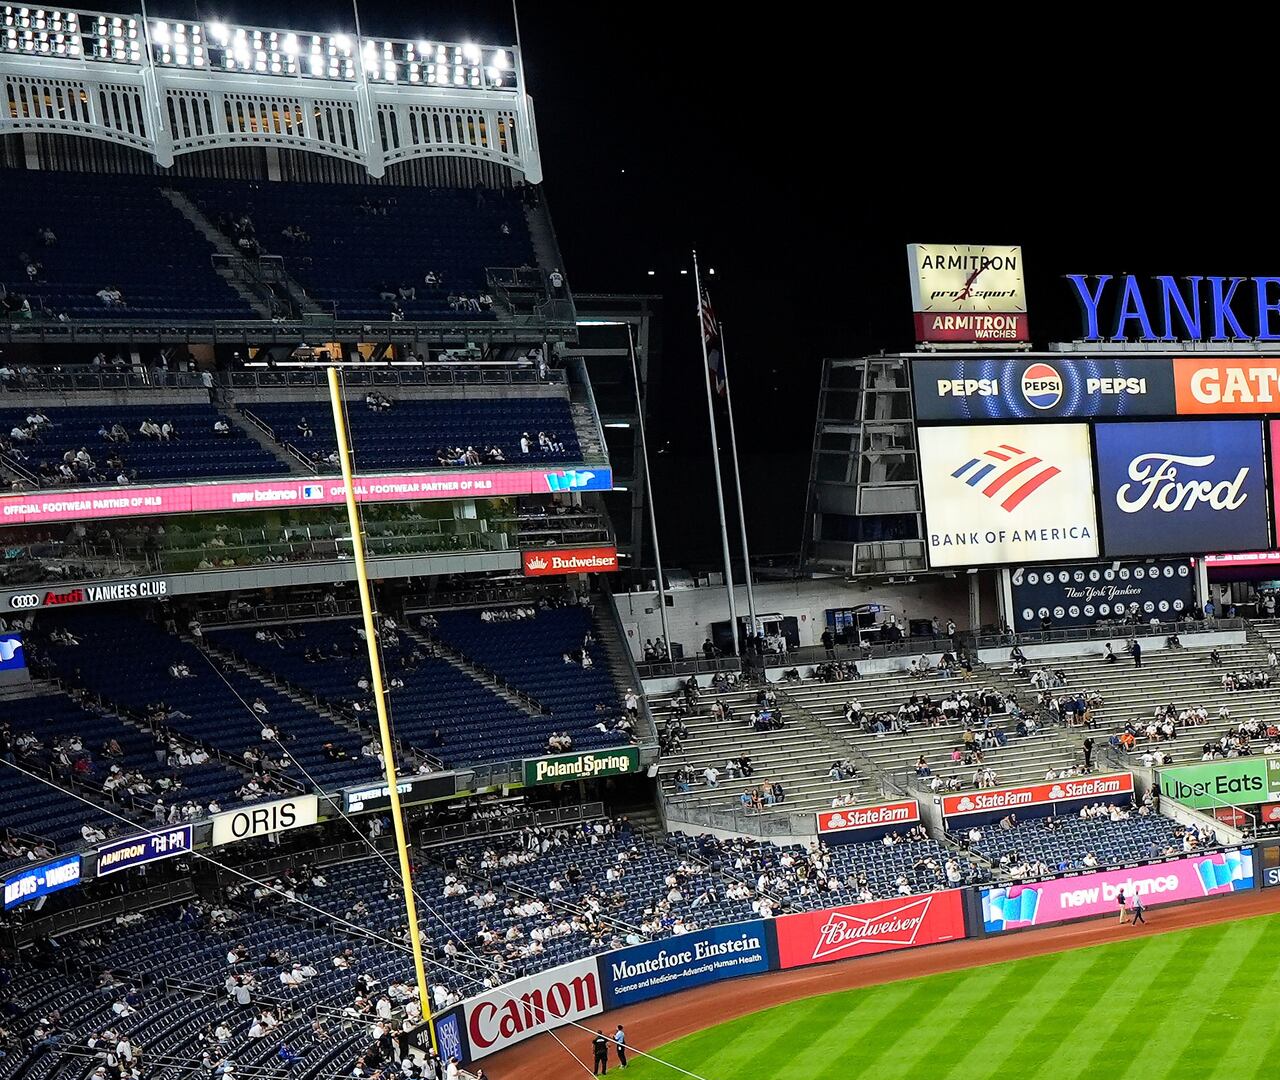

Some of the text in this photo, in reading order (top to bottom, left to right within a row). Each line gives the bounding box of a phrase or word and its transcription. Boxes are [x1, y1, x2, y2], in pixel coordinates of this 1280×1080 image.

[922, 256, 1016, 270] ARMITRON
[933, 317, 1016, 329] ARMITRON
[975, 330, 1016, 338] WATCHES
[938, 380, 998, 396] PEPSI
[1025, 381, 1059, 390] PEPSI
[1087, 378, 1147, 394] PEPSI
[1116, 453, 1248, 513] Ford
[932, 527, 1090, 546] BANK OF AMERICA
[552, 556, 614, 569] Budweiser
[1064, 585, 1141, 601] New York Yankees
[1165, 774, 1263, 800] Uber Eats
[232, 803, 295, 838] ORIS
[821, 917, 920, 944] Budweiser
[612, 935, 760, 981] Montefiore Einstein
[615, 980, 637, 994] Science
[638, 978, 649, 988] and
[714, 959, 738, 970] Human
[739, 954, 762, 965] Health
[470, 972, 598, 1048] Canon
[417, 1032, 429, 1046] 318
